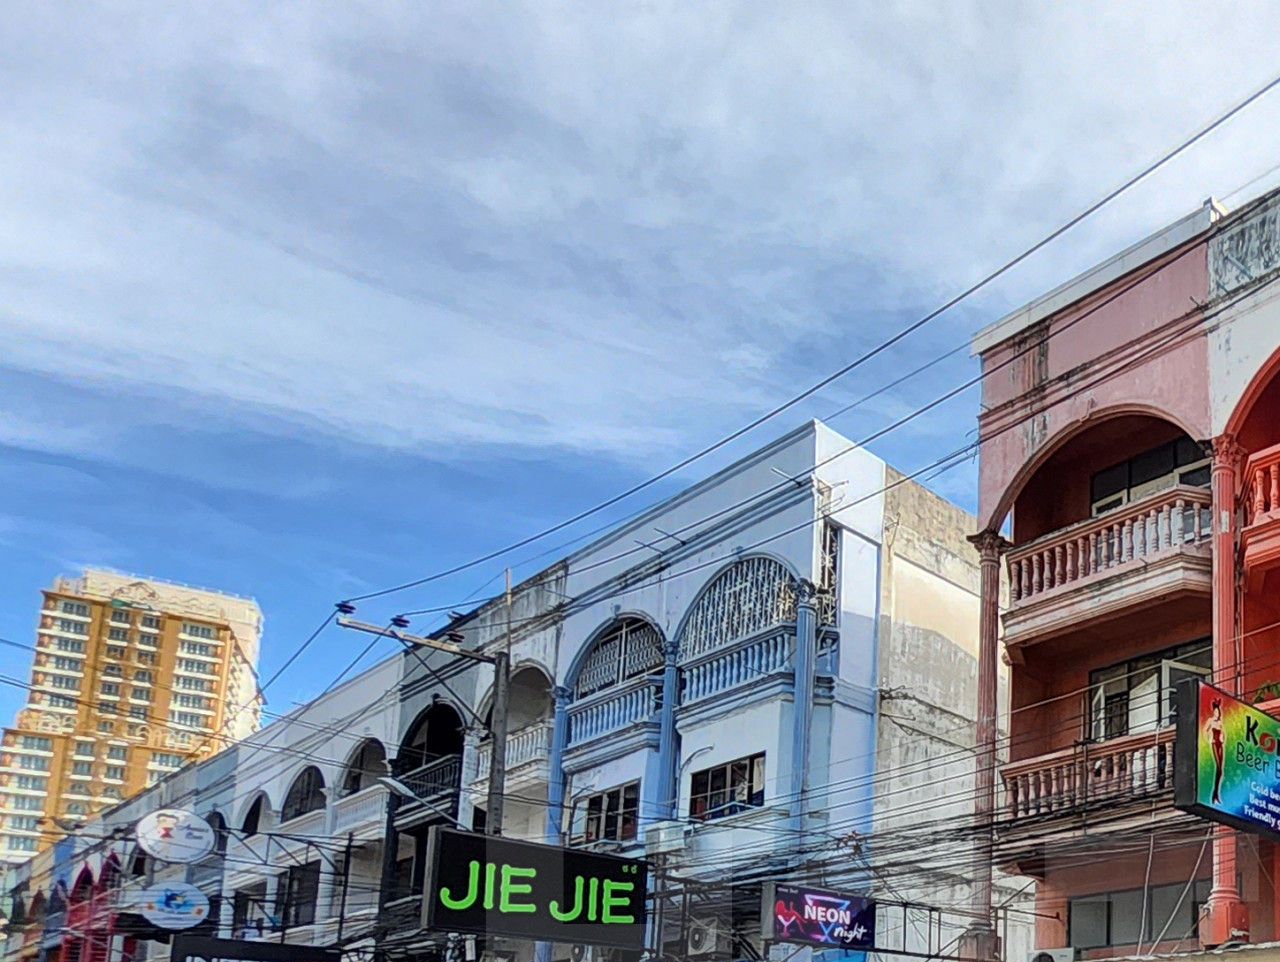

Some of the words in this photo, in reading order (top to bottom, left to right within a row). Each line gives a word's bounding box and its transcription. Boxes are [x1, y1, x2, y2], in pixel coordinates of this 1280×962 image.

[1236, 742, 1270, 773] Beer
[1250, 781, 1269, 797] Cold
[1249, 793, 1267, 809] Best
[1244, 805, 1276, 827] Friendly
[440, 860, 536, 913] JIE
[549, 875, 634, 924] JIE
[804, 905, 851, 925] NEON
[833, 923, 867, 943] night
